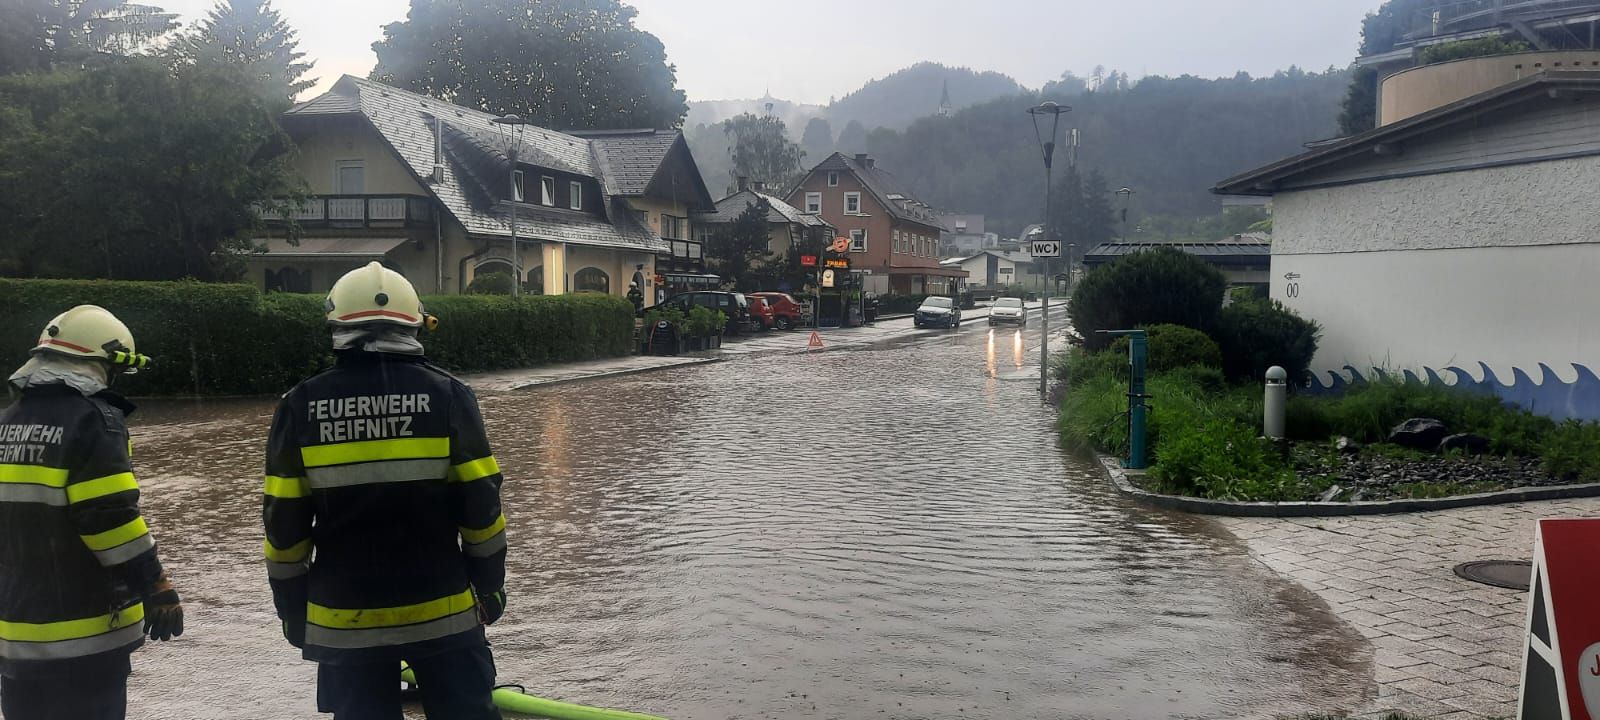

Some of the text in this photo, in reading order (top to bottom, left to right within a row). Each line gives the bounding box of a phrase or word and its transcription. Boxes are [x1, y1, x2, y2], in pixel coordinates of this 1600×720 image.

[1034, 244, 1051, 254] WC
[308, 393, 431, 421] FEUERWEHR
[320, 416, 413, 442] REIFNITZ
